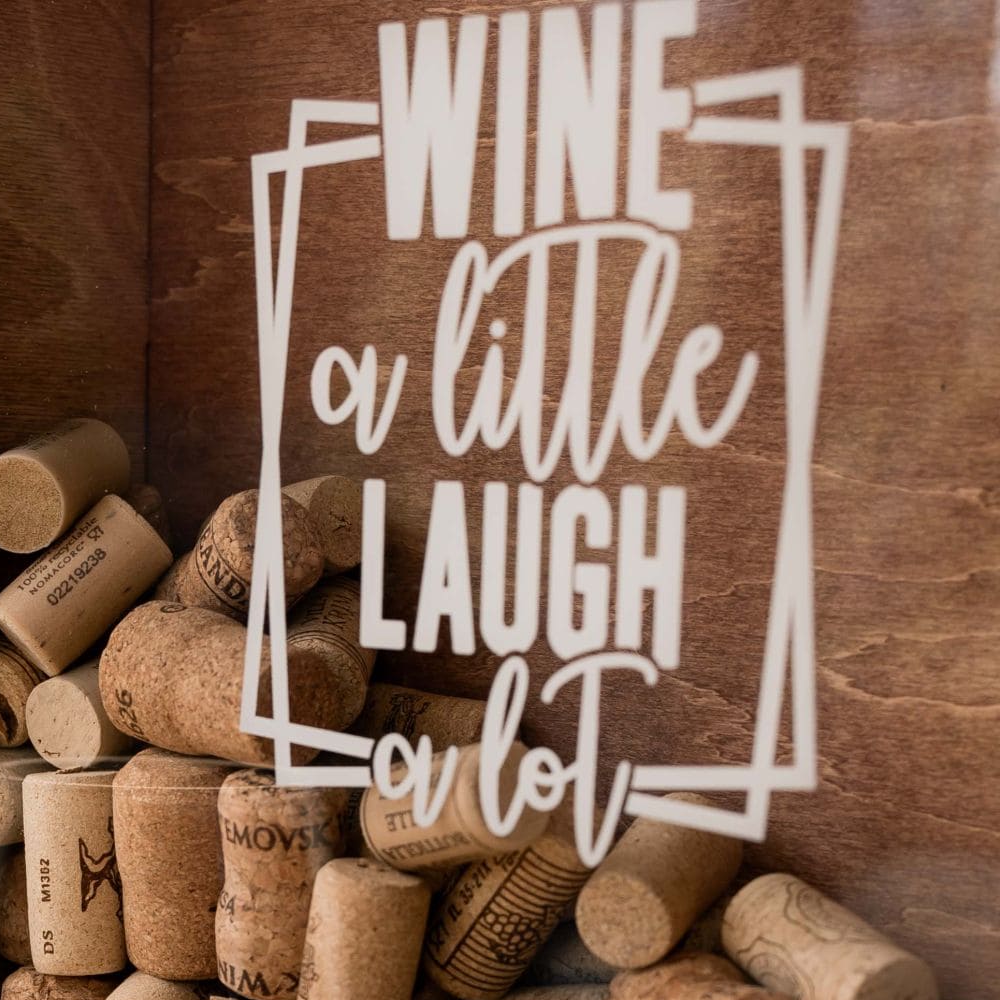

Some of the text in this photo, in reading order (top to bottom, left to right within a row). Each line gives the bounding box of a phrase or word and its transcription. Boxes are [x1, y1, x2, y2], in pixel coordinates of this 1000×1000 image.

[378, 0, 698, 239] WINE
[311, 220, 758, 481] a little
[46, 547, 107, 607] 02219238
[360, 479, 686, 669] LAUGH
[373, 655, 658, 868] a lot
[43, 929, 55, 956] DS
